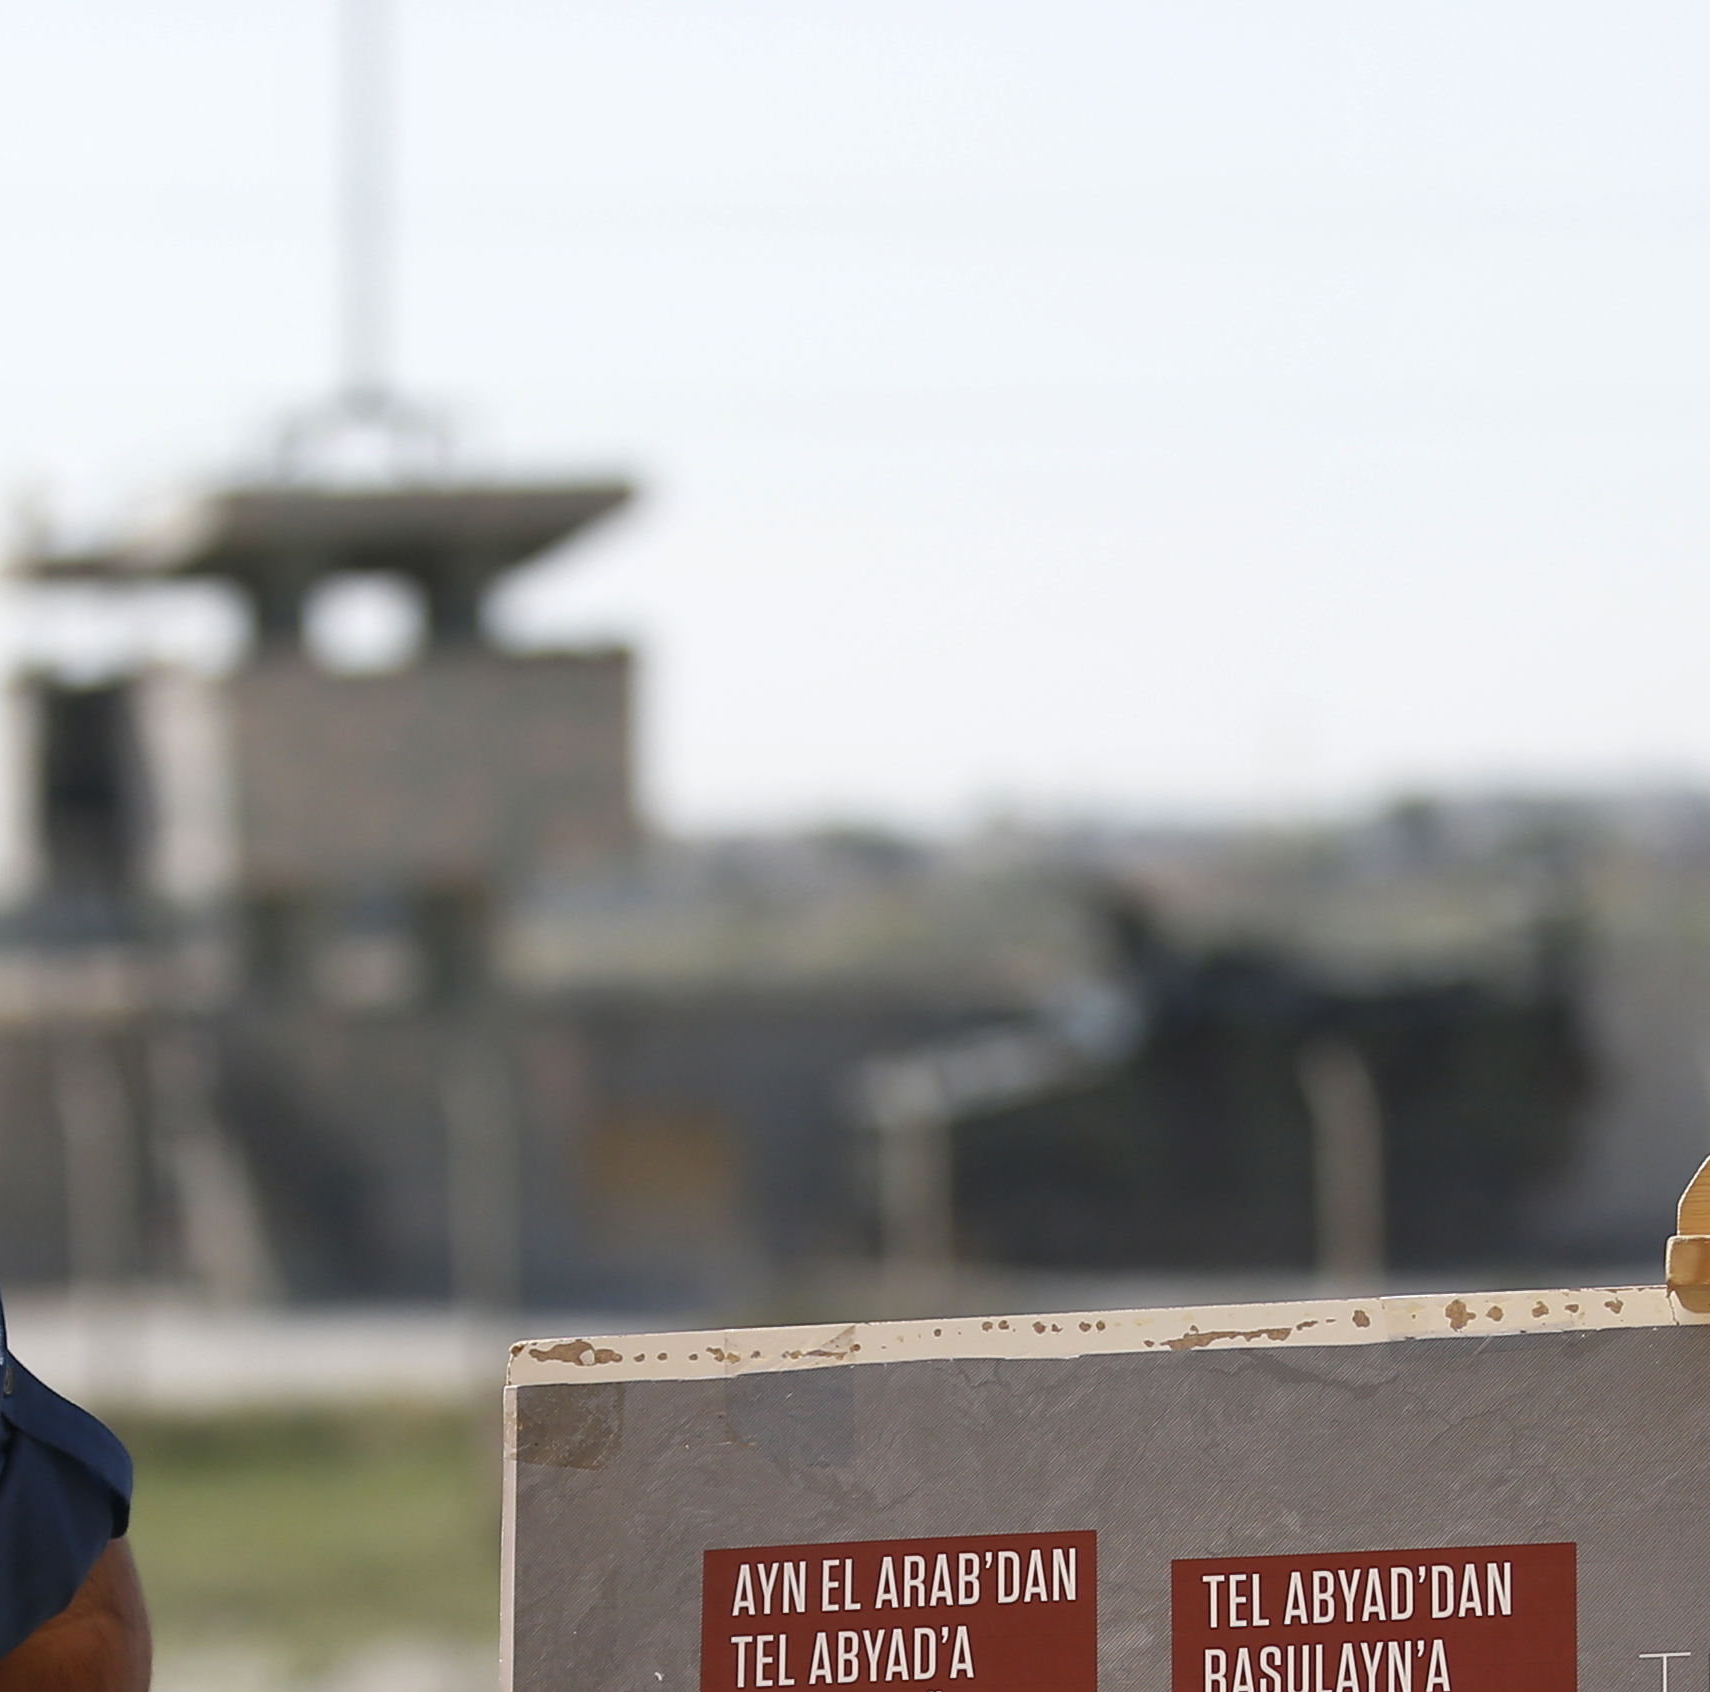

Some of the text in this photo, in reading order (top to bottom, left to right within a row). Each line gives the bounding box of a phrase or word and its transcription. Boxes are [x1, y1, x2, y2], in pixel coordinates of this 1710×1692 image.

[731, 1547, 1077, 1617] AYN EL ARAB'DAN
[1201, 1561, 1512, 1628] TEL ABYAD'DAN
[731, 1625, 974, 1688] TEL ABYAD'A
